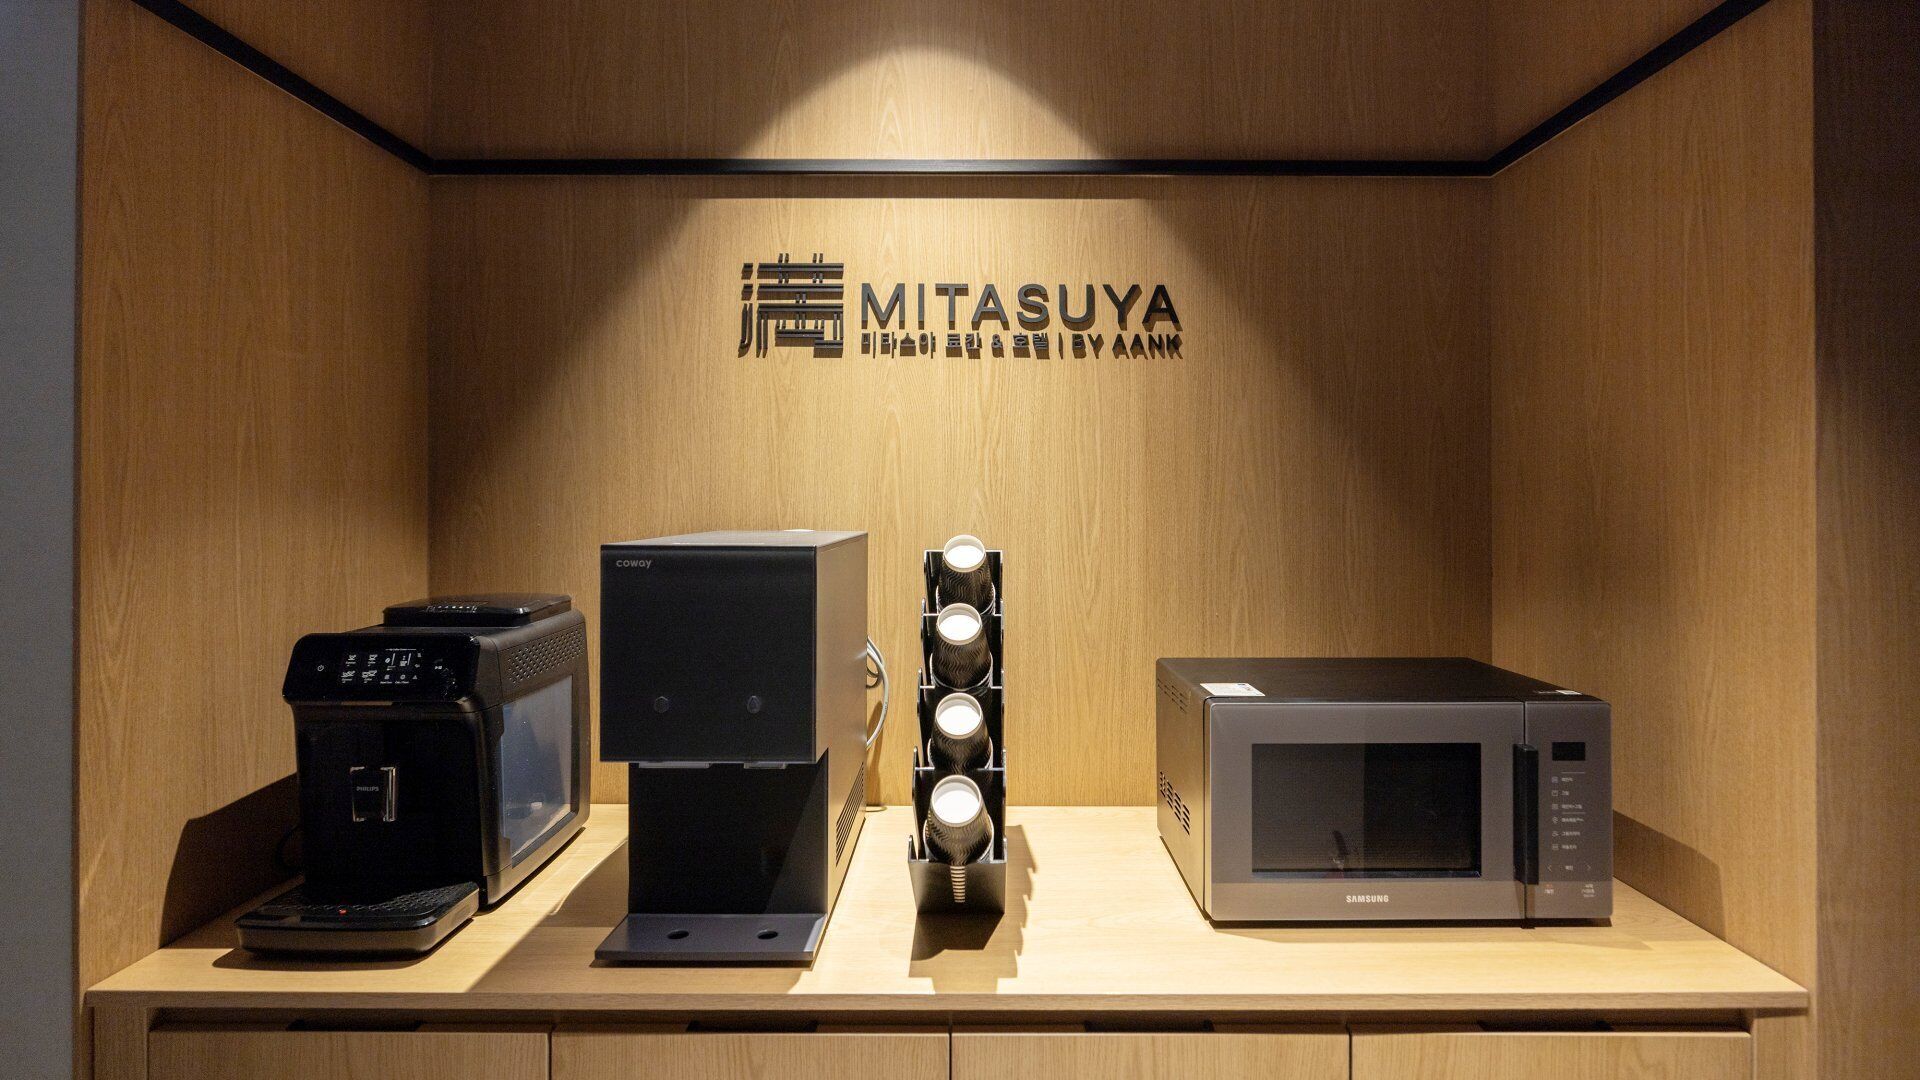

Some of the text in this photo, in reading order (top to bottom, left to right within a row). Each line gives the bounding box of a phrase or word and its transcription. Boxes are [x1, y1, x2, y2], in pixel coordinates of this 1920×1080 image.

[861, 283, 1179, 328] MITASUYA
[946, 332, 982, 353] 료칸
[991, 333, 1004, 353] &
[1012, 332, 1049, 354] 호텔
[1072, 333, 1104, 354] BY
[1112, 333, 1183, 354] AANK
[616, 559, 652, 569] coway
[1345, 895, 1389, 903] SAMSUNG
